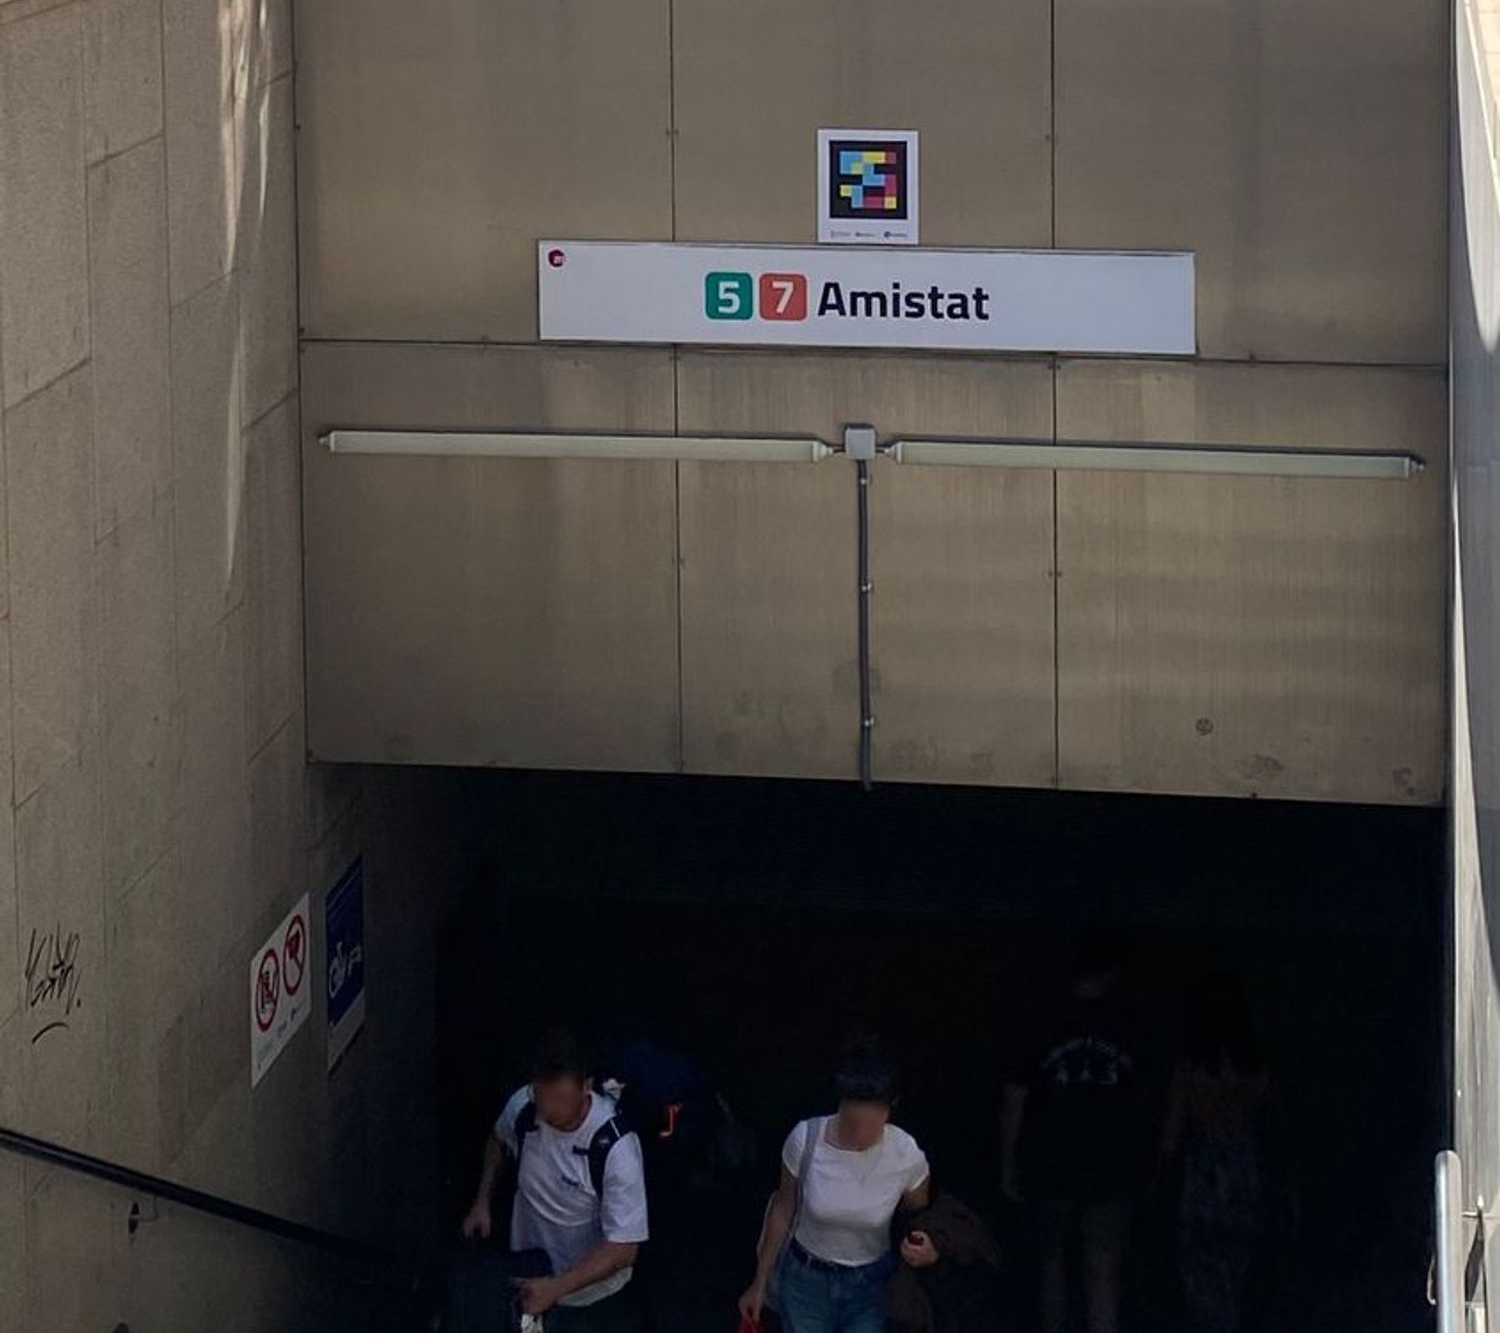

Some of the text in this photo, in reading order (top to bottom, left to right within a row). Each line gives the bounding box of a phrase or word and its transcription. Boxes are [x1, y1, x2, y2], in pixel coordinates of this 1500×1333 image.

[717, 280, 990, 320] 5 7 Amistat
